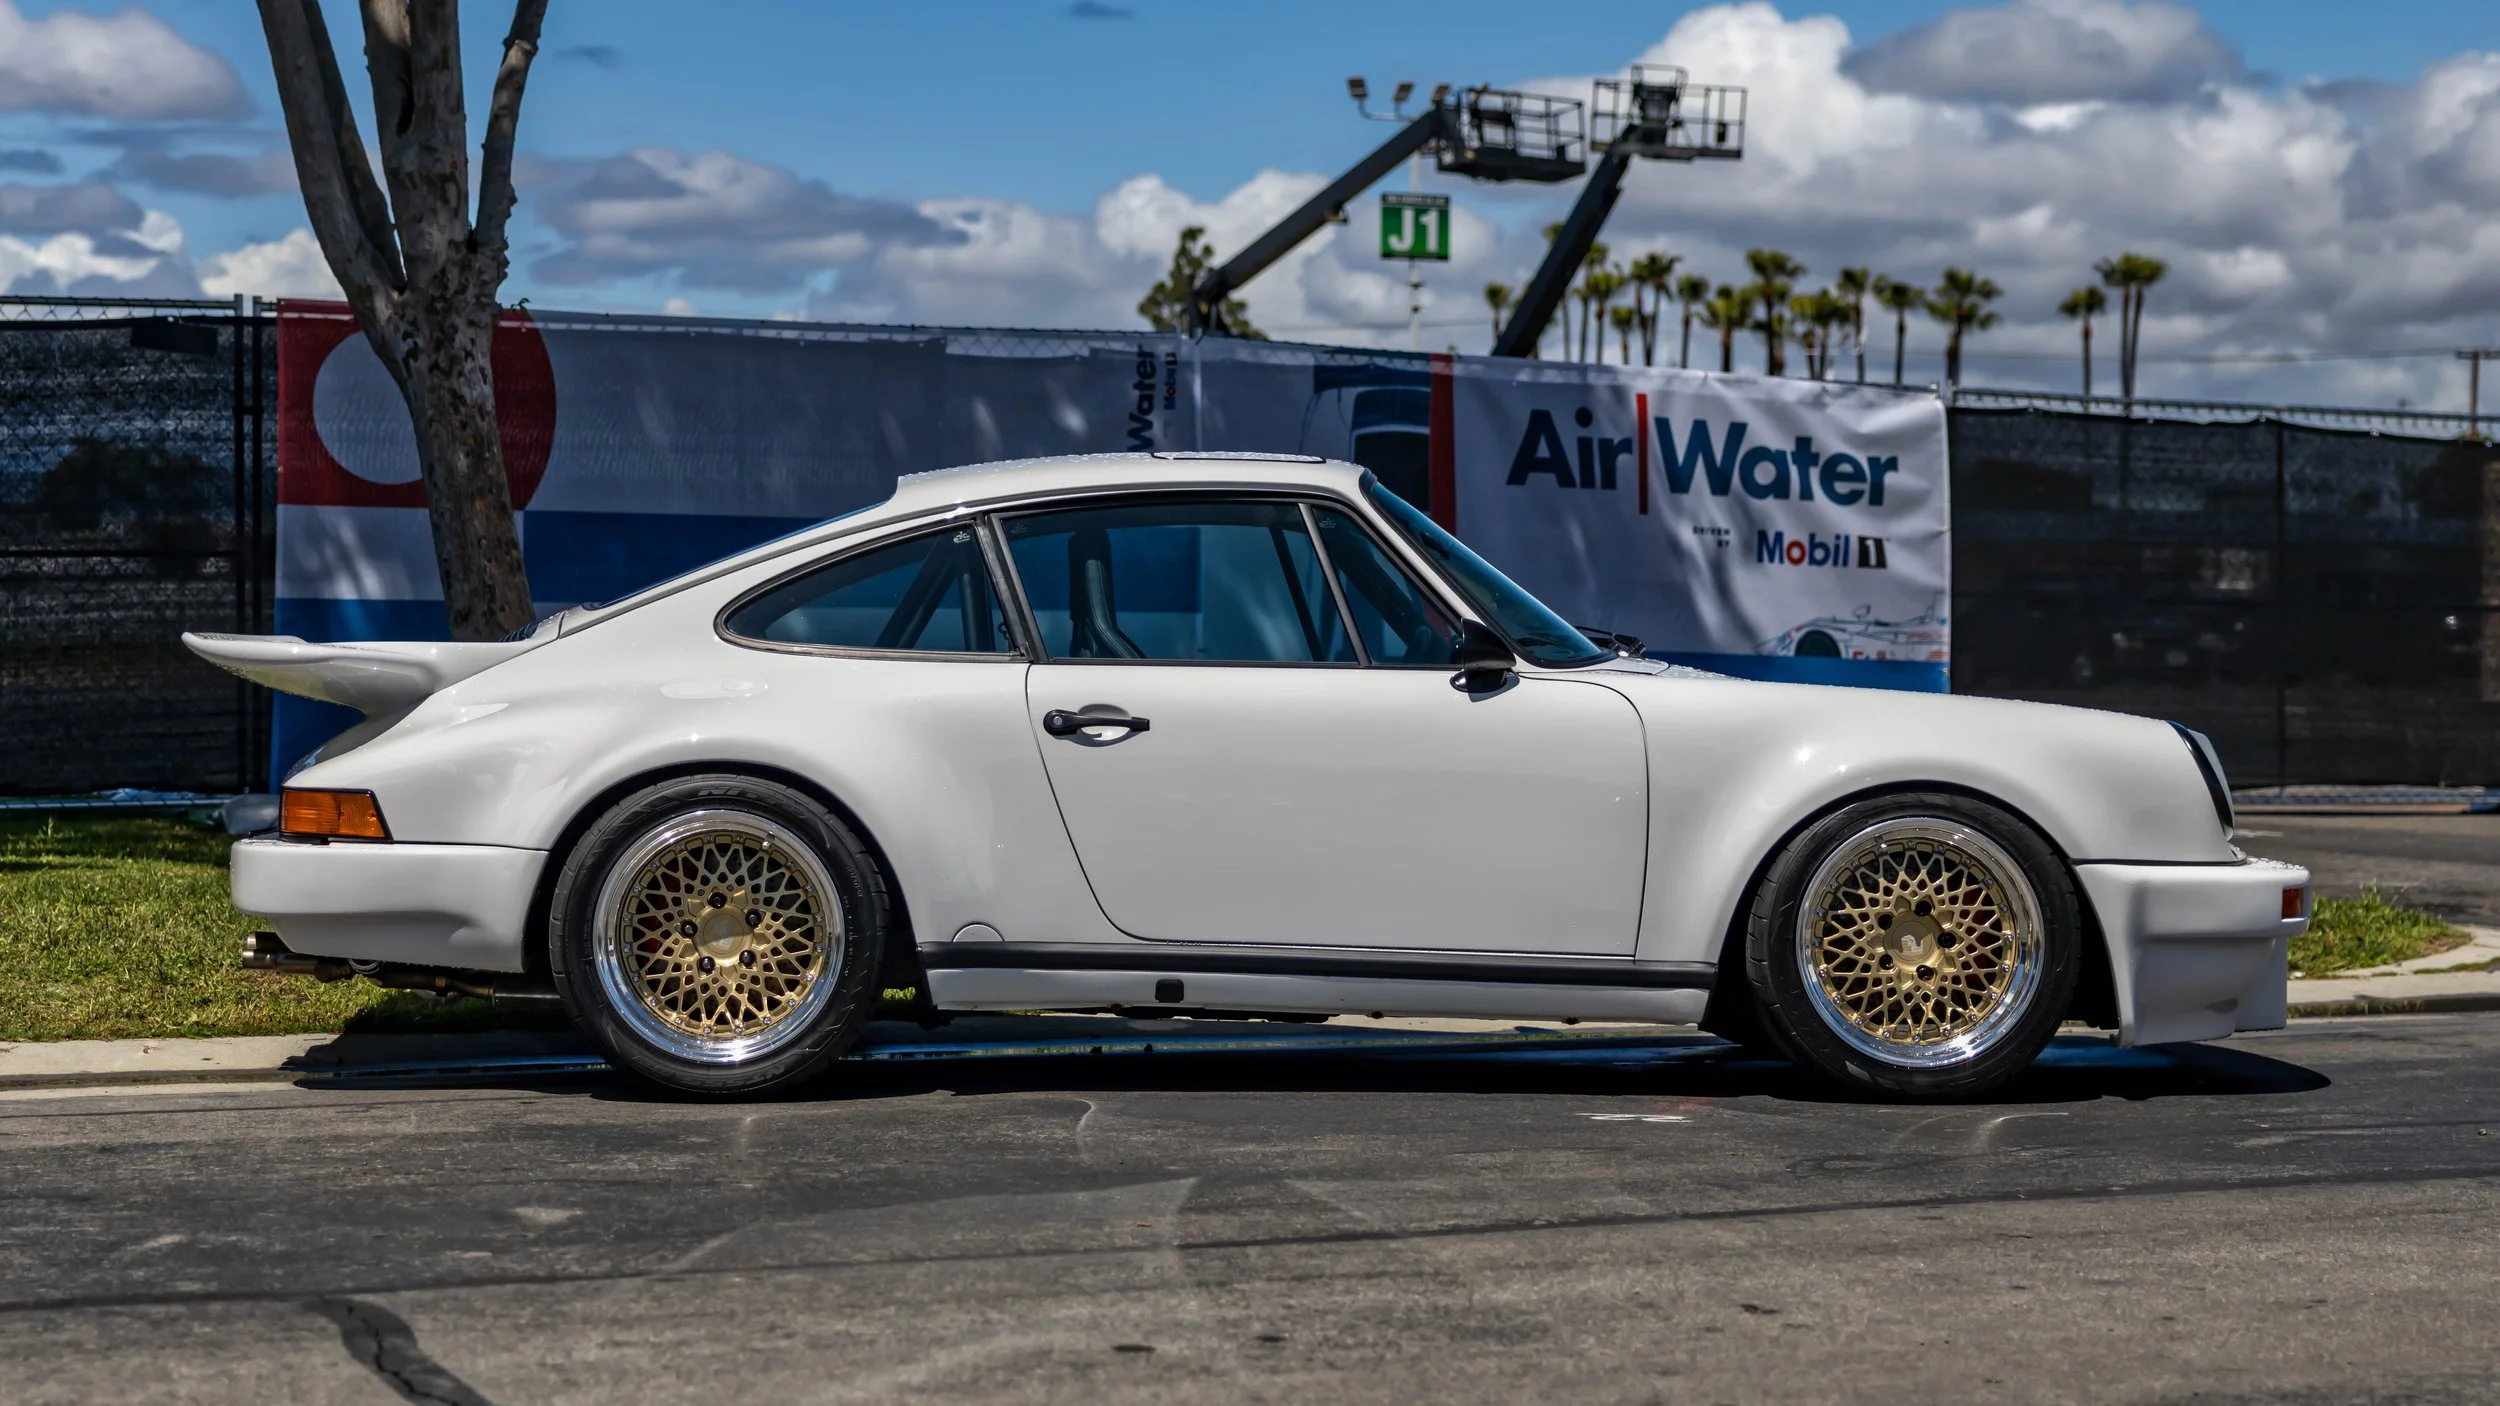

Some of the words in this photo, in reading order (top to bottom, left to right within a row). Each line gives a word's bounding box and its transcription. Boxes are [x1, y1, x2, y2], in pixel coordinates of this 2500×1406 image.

[1387, 207, 1439, 252] J1
[1126, 343, 1156, 452] Water
[1506, 406, 1633, 491] Air
[1654, 416, 1898, 507] Water
[1756, 529, 1850, 568] Mobil
